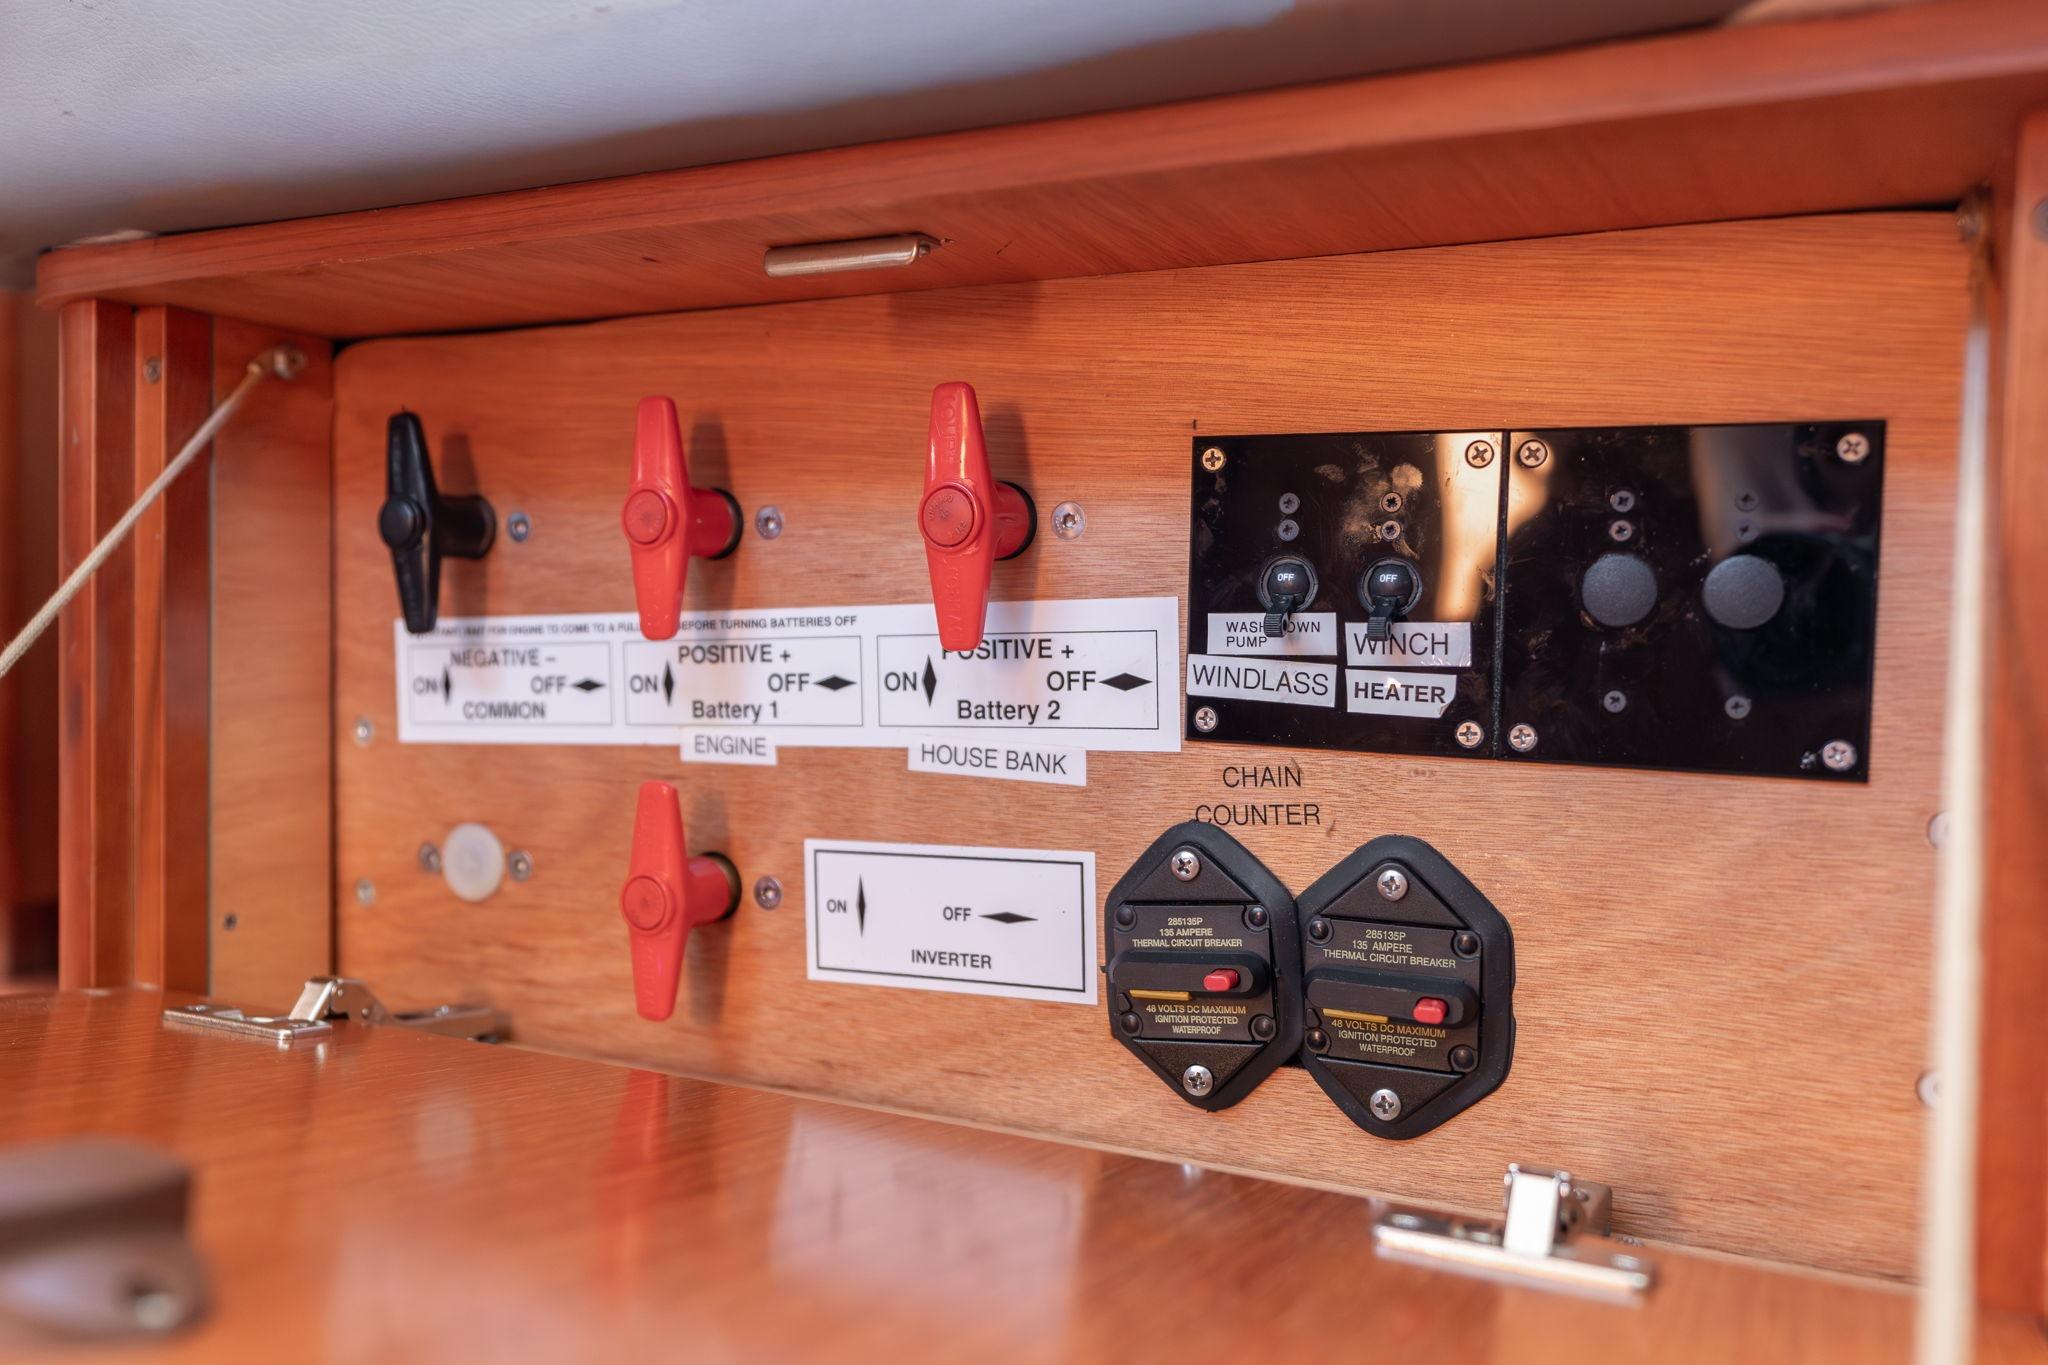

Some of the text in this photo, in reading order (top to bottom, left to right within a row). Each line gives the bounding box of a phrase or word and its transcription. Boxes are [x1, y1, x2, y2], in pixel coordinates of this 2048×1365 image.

[1277, 573, 1294, 582] OFF
[1379, 574, 1397, 583] OFF
[720, 618, 767, 630] TURNING
[770, 616, 832, 628] BATTERIES
[834, 616, 857, 627] OFF
[1226, 621, 1321, 633] WASHOWN
[1226, 637, 1267, 648] PUMP
[1354, 633, 1448, 655] WINCH
[450, 648, 541, 668] NEGATIVE
[678, 645, 773, 664] POSITIVE
[413, 677, 438, 694] ON
[530, 676, 567, 693] OFF
[630, 675, 659, 693] ON
[768, 673, 810, 692] OFF
[884, 672, 917, 691] ON
[1046, 671, 1096, 691] OFF
[1193, 664, 1329, 696] WINDLASS
[1354, 681, 1446, 703] HEATER
[463, 702, 547, 719] COMMON
[692, 700, 778, 723] Battery 1
[957, 700, 1061, 724] Battery 2
[694, 735, 767, 756] ENGINE
[921, 744, 1068, 775] HOUSE BANK
[1222, 766, 1301, 788] CHAIN
[1195, 804, 1320, 825] COUNTER
[826, 899, 847, 913] ON
[943, 907, 972, 922] OFF
[1168, 917, 1203, 926] 285135P
[1160, 928, 1213, 937] 135 AMPERE
[1366, 929, 1406, 940] 285135P
[1132, 938, 1243, 947] THERMAL CIRCUIT BREAKER
[1353, 940, 1413, 953] 135 AMPERE
[912, 949, 992, 969] INVERTER
[1323, 948, 1456, 968] THERMAL CIRCUIT BREAKER
[1146, 1004, 1246, 1014] 48 VOLTS DC MAXIMUM
[1155, 1014, 1238, 1024] IGNITION PROTECTED
[1172, 1025, 1221, 1034] WATERPROOF
[1331, 1019, 1446, 1038] 48 VOLTS DC MAXIMUM
[1338, 1030, 1437, 1048] IGNITION PROTECTED
[1359, 1043, 1415, 1056] WATERPROOF
